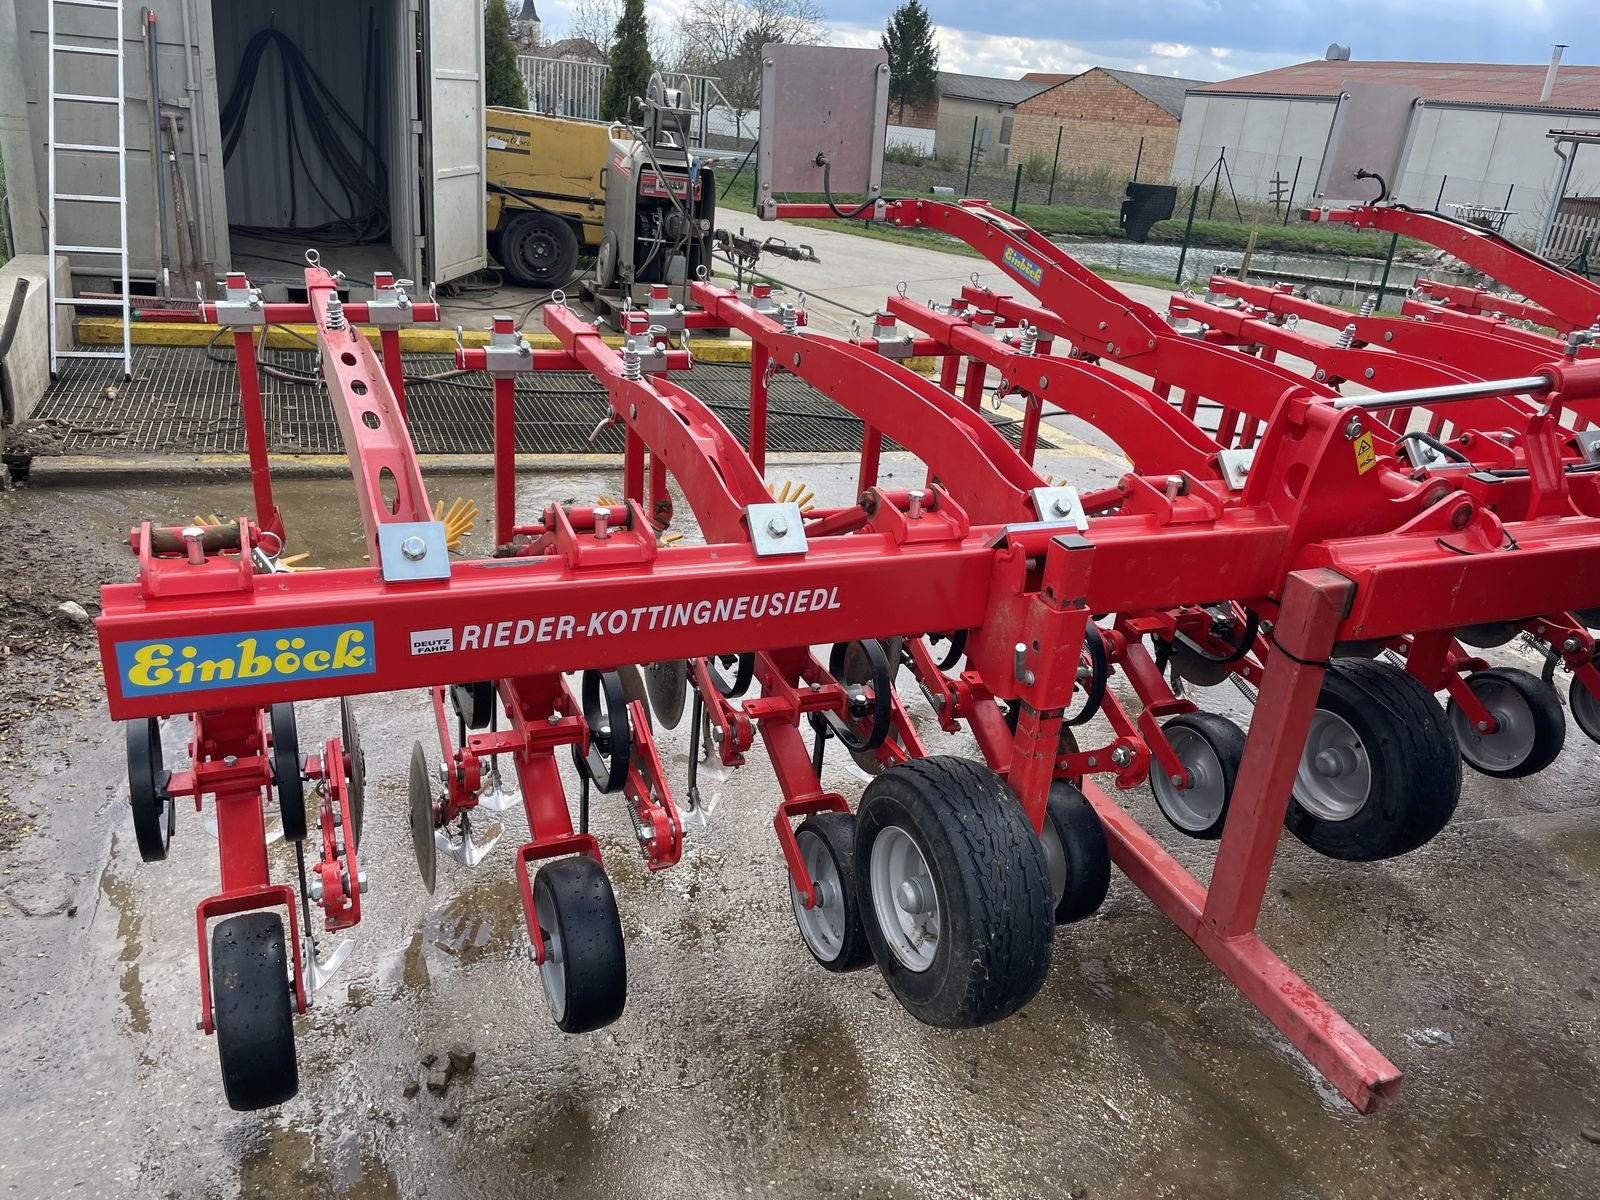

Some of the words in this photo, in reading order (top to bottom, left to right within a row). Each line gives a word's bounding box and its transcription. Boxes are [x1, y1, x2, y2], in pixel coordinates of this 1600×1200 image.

[1005, 247, 1042, 281] Einböck
[459, 586, 841, 651] RIEDER-KOTTINGNEUSIEDL
[128, 629, 366, 686] Einböck
[414, 639, 450, 647] DEUTZ
